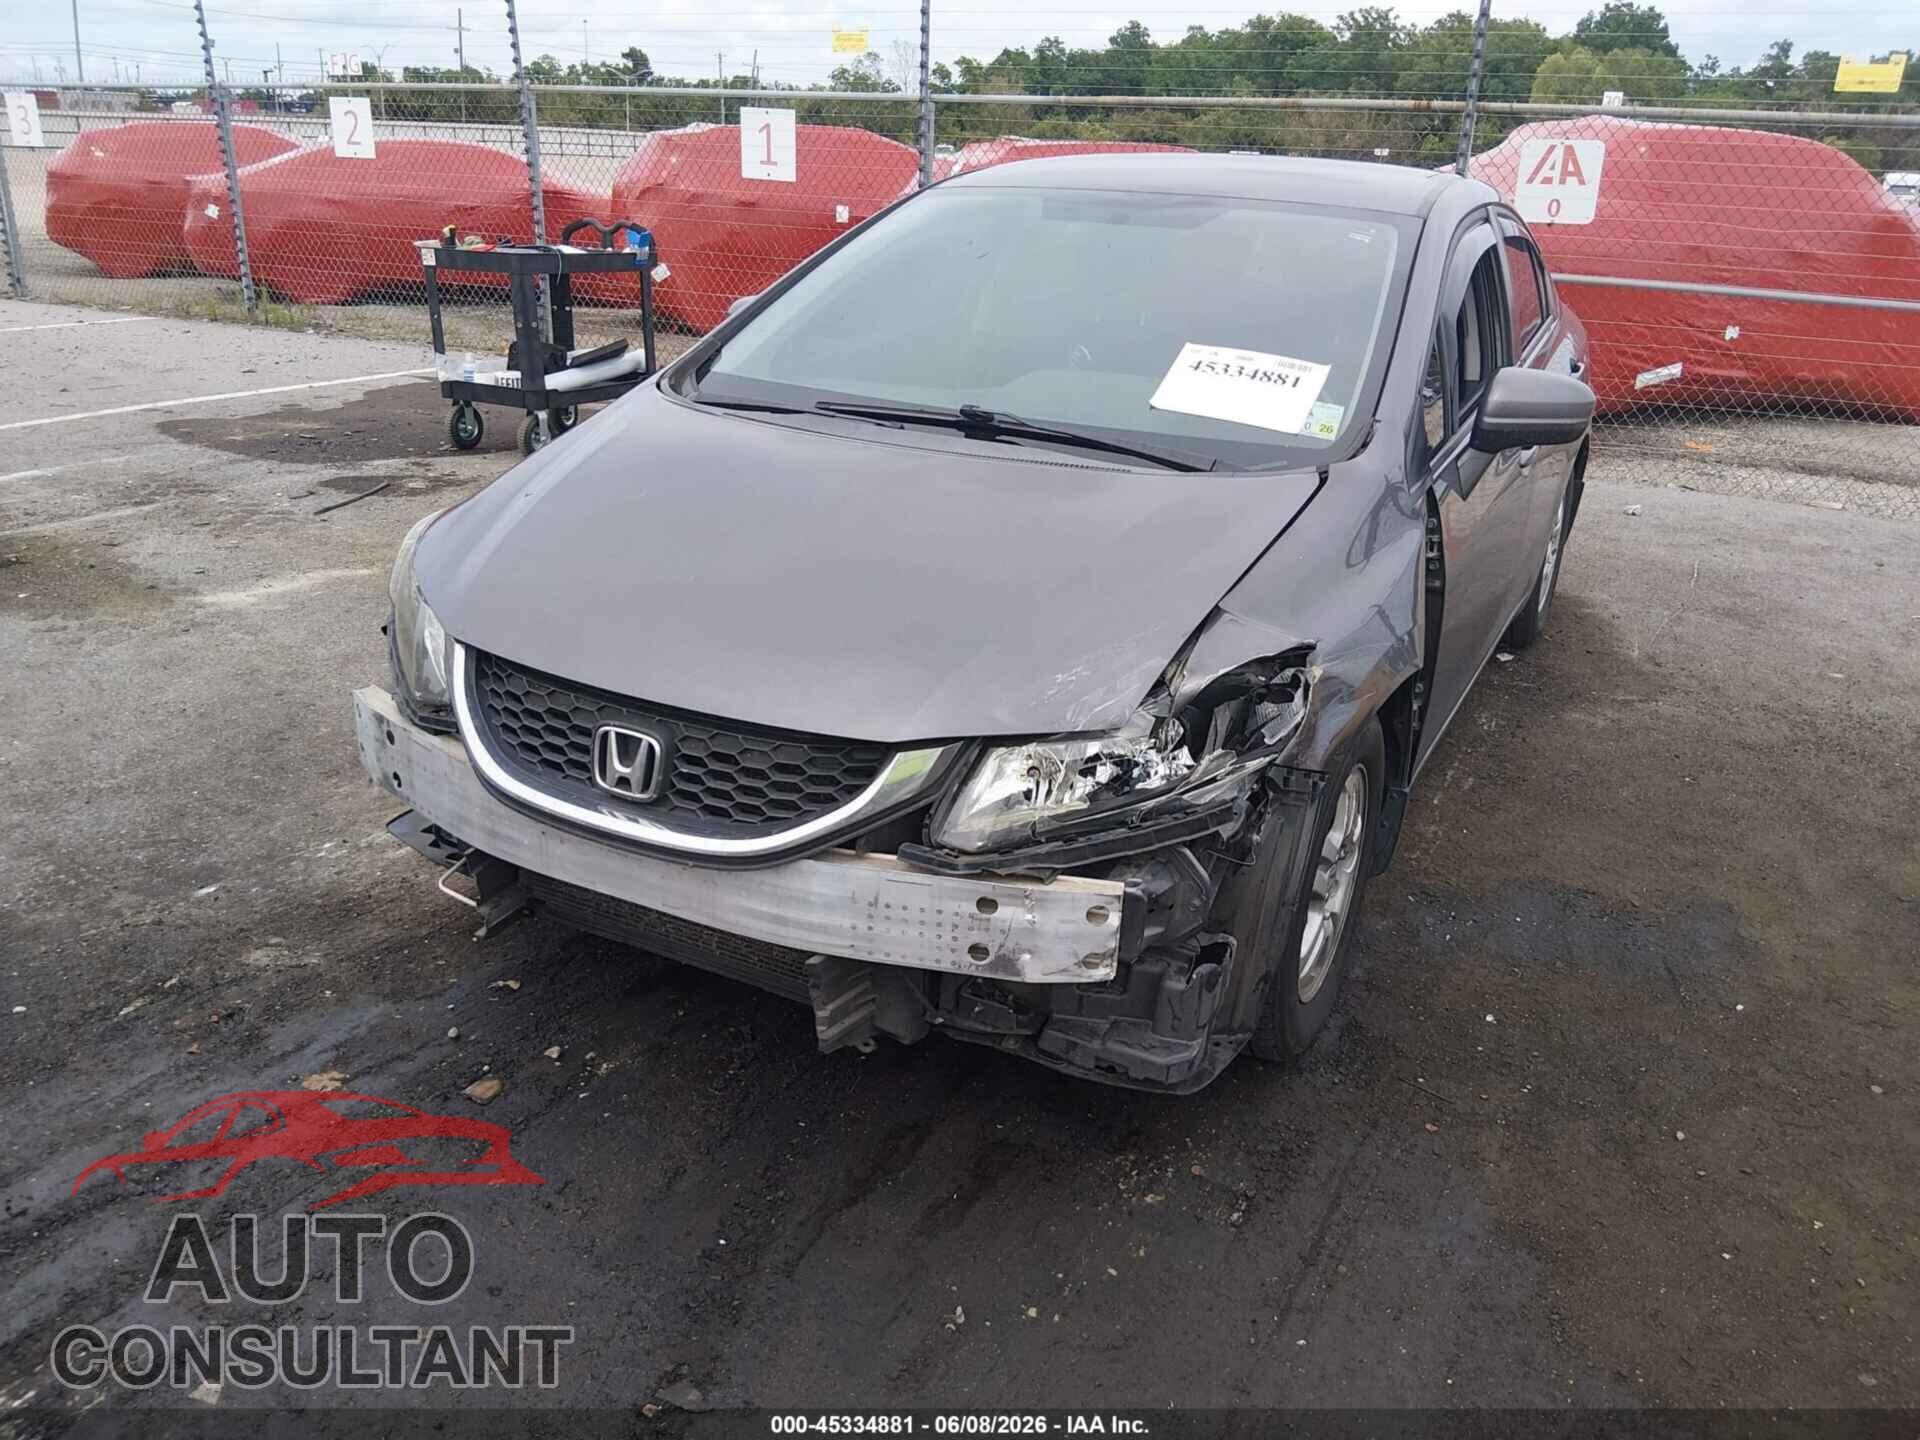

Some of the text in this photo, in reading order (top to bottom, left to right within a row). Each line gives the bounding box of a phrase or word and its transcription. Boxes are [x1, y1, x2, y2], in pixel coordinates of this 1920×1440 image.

[17, 105, 32, 135] 3
[344, 110, 362, 146] 2
[758, 122, 778, 167] 1
[1547, 198, 1561, 218] 0
[1188, 360, 1301, 389] 45334881
[1319, 423, 1334, 434] 26
